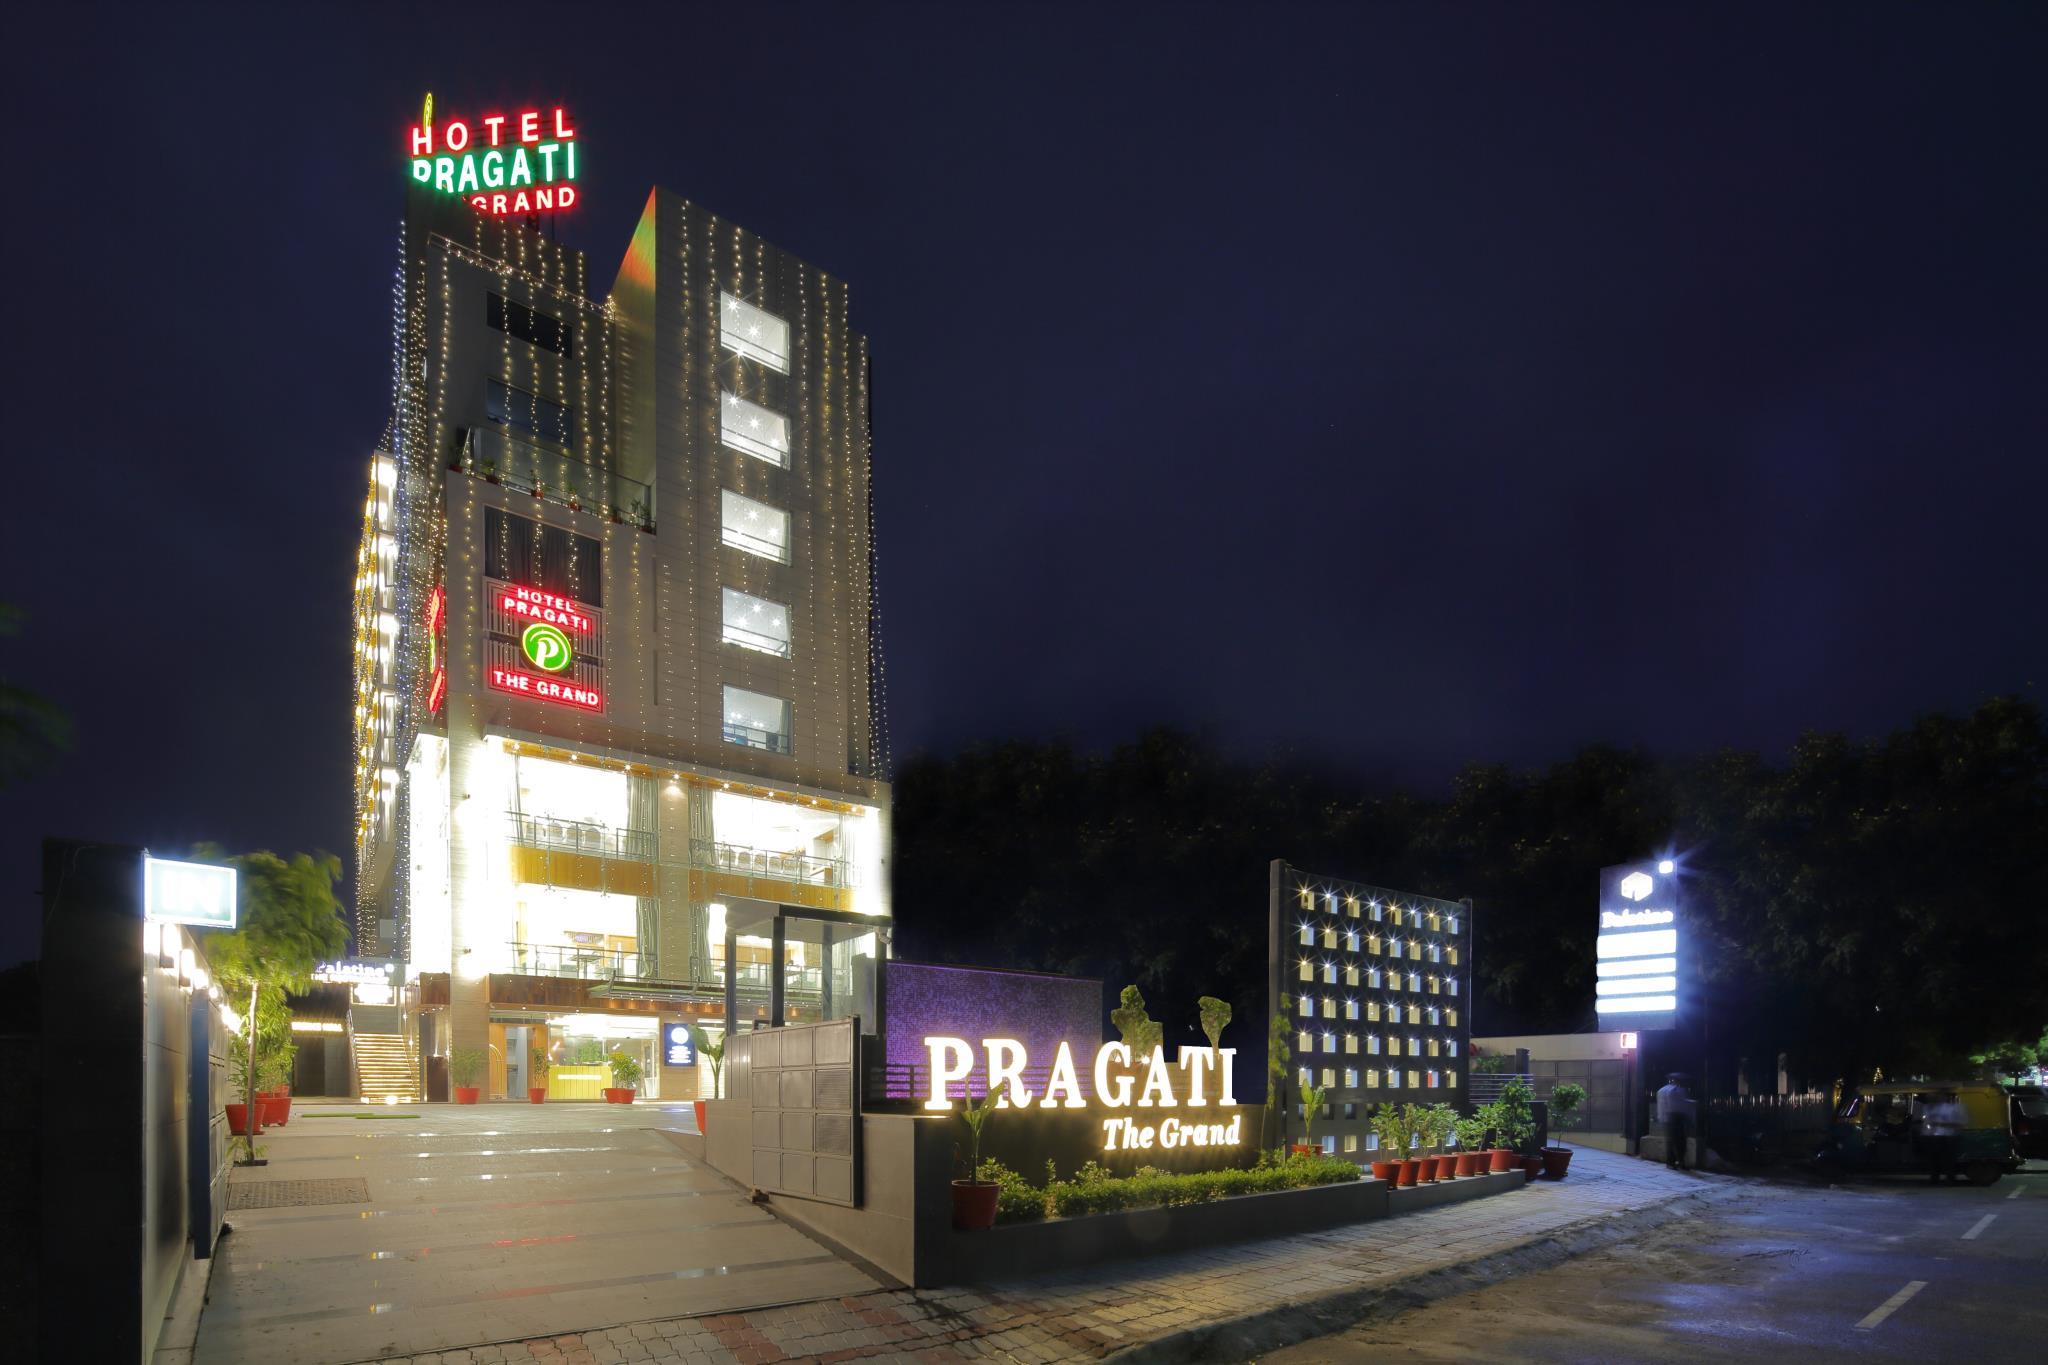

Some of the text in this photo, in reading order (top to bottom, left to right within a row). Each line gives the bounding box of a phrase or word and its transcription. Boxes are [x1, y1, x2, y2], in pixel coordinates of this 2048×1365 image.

[412, 109, 573, 155] HOTEL
[412, 142, 575, 193] PRAGATI
[504, 598, 587, 630] PRAGATI
[517, 588, 575, 612] HOTEL
[493, 671, 599, 705] THE GRAND
[924, 1037, 1237, 1110] PRAGATI
[1103, 1115, 1241, 1151] The Grand
